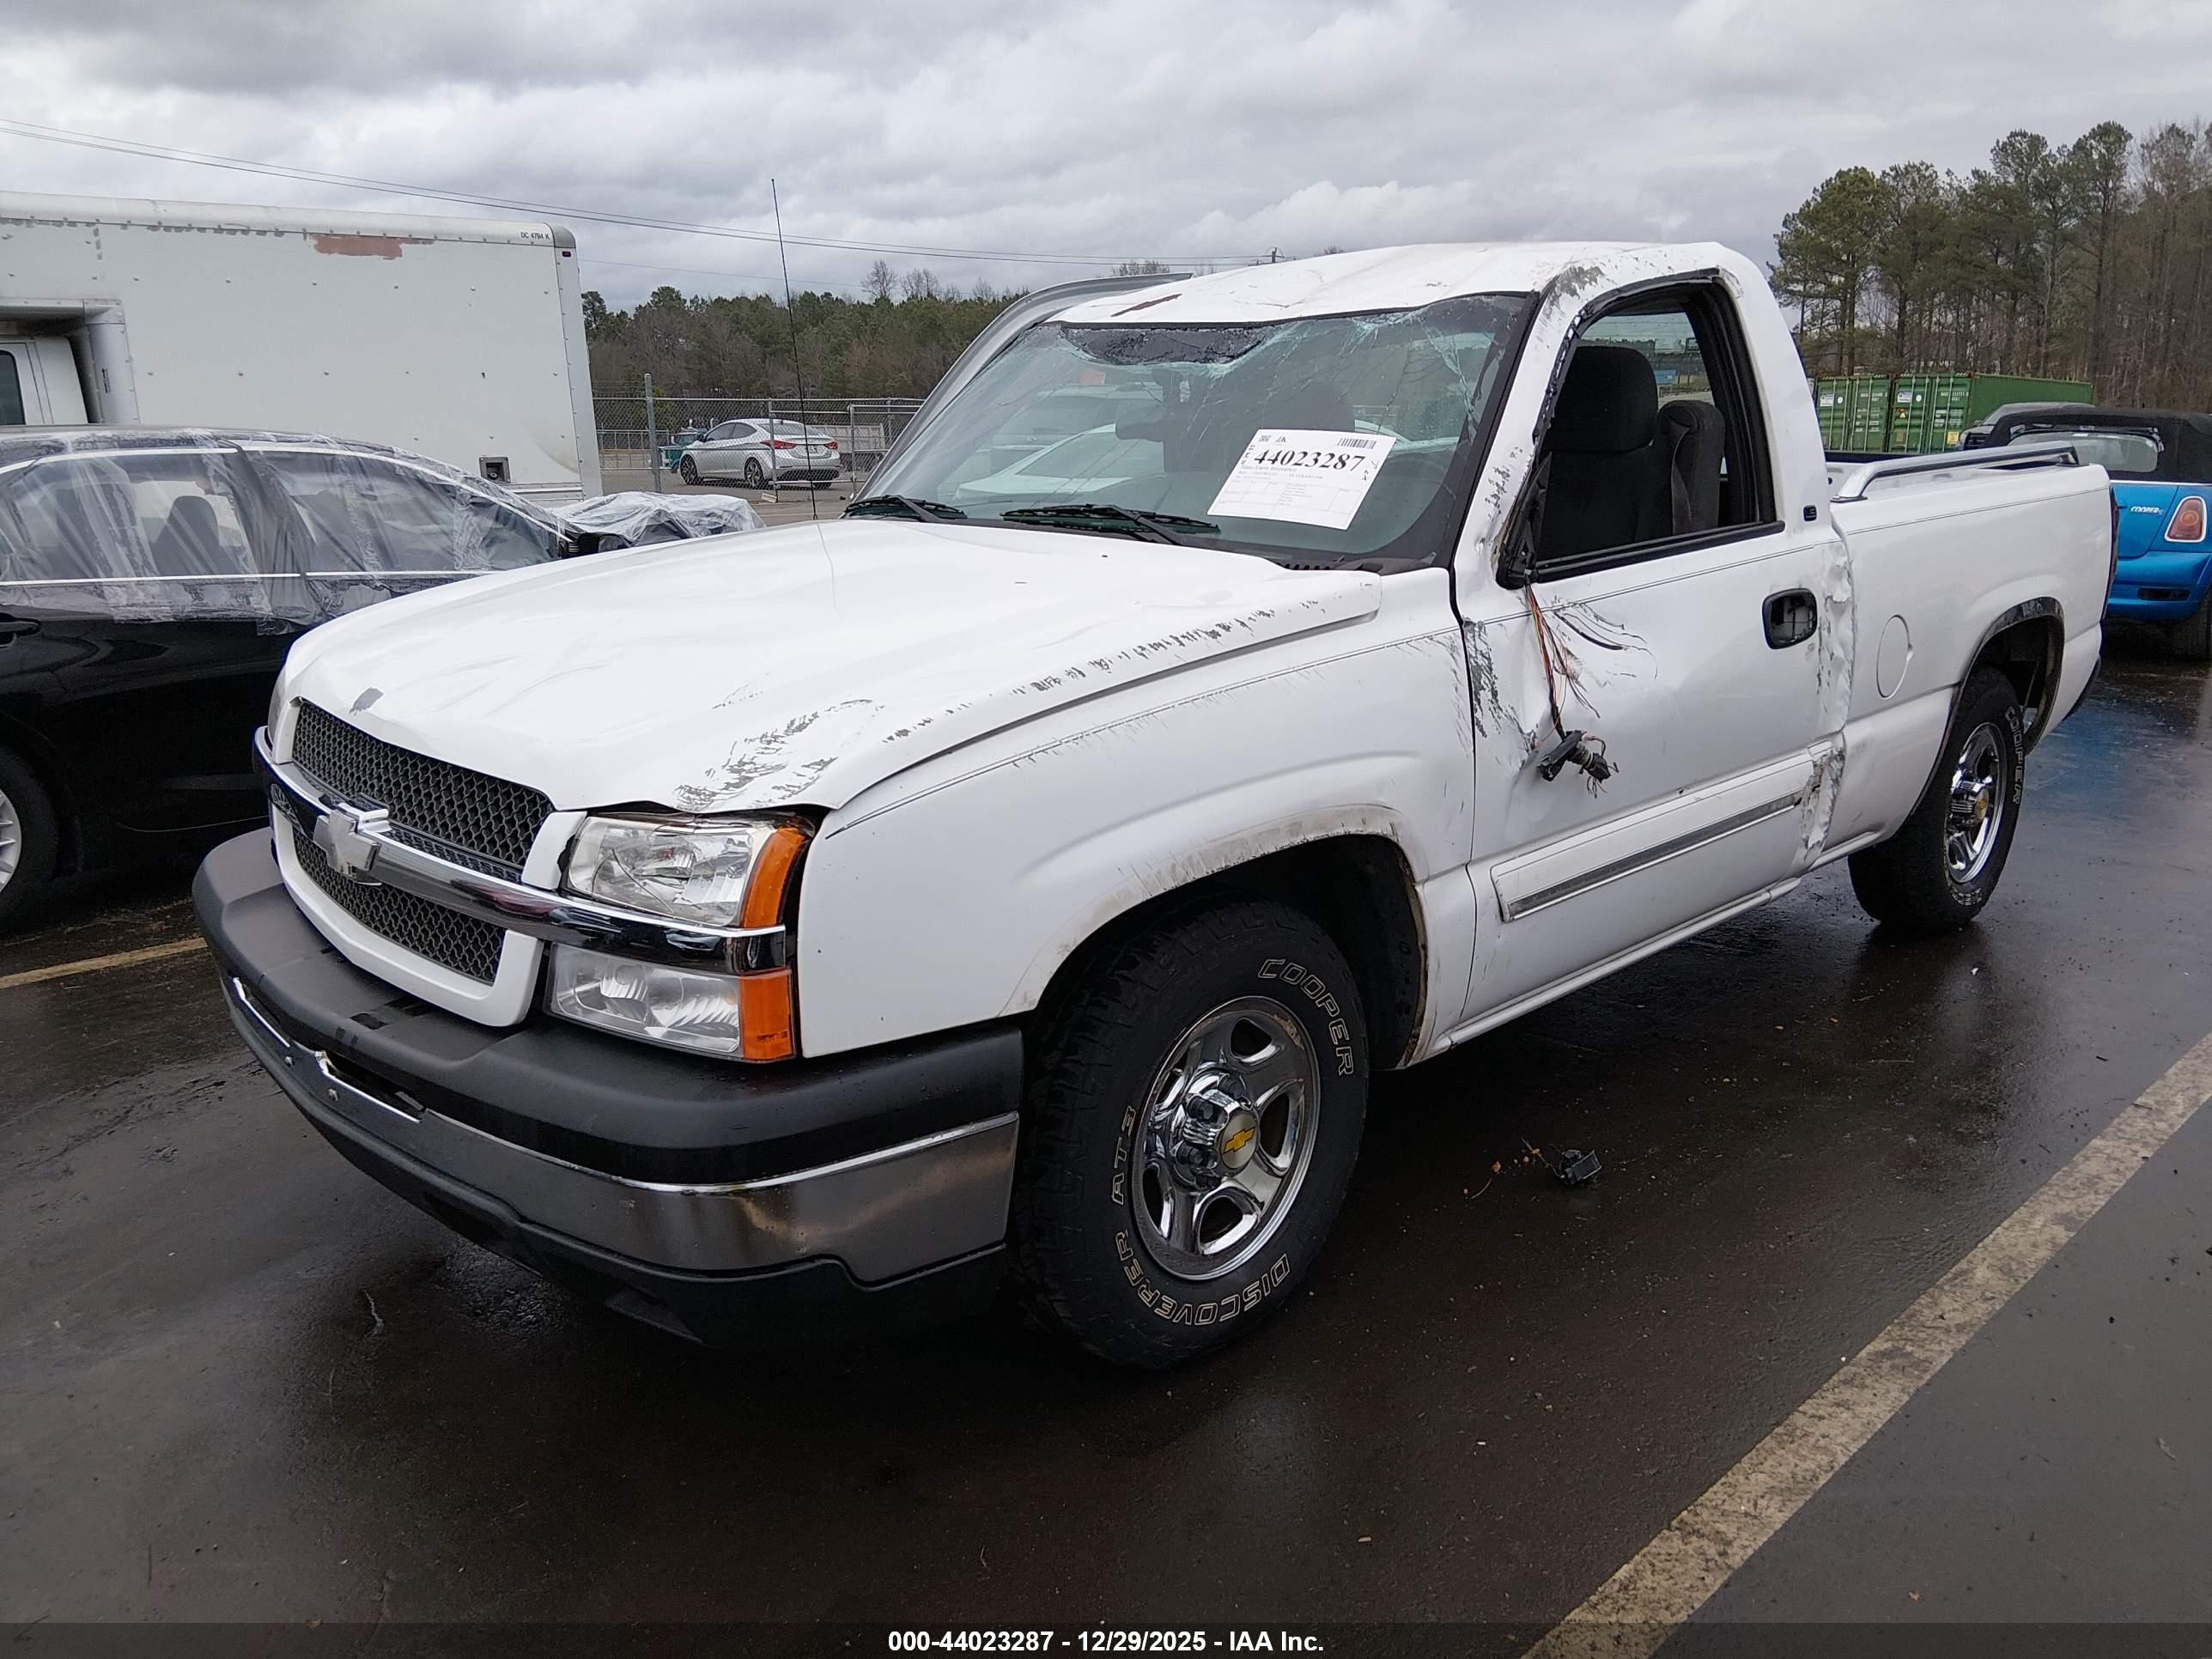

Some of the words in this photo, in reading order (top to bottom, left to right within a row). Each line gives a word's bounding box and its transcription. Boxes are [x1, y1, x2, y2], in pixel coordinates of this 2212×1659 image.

[1254, 449, 1365, 472] 44023287
[2004, 705, 2024, 805] COOPER
[1256, 957, 1354, 1078] COOPER
[1115, 1229, 1290, 1326] DISCOVERER
